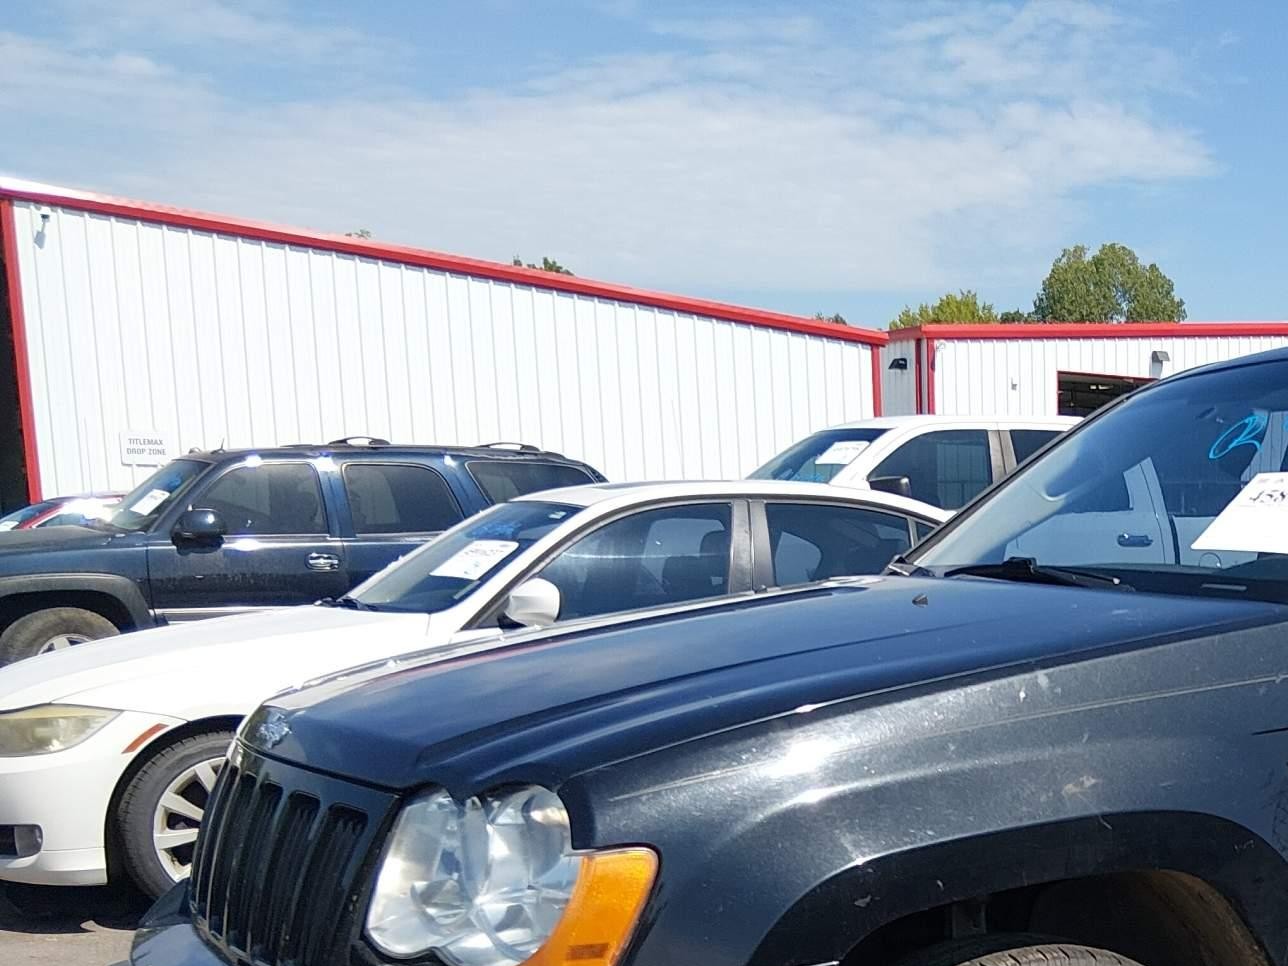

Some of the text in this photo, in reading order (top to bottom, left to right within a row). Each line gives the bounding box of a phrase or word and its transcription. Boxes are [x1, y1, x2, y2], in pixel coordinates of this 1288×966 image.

[127, 437, 164, 446] TITLEMAX
[126, 447, 167, 456] DROP ZONE
